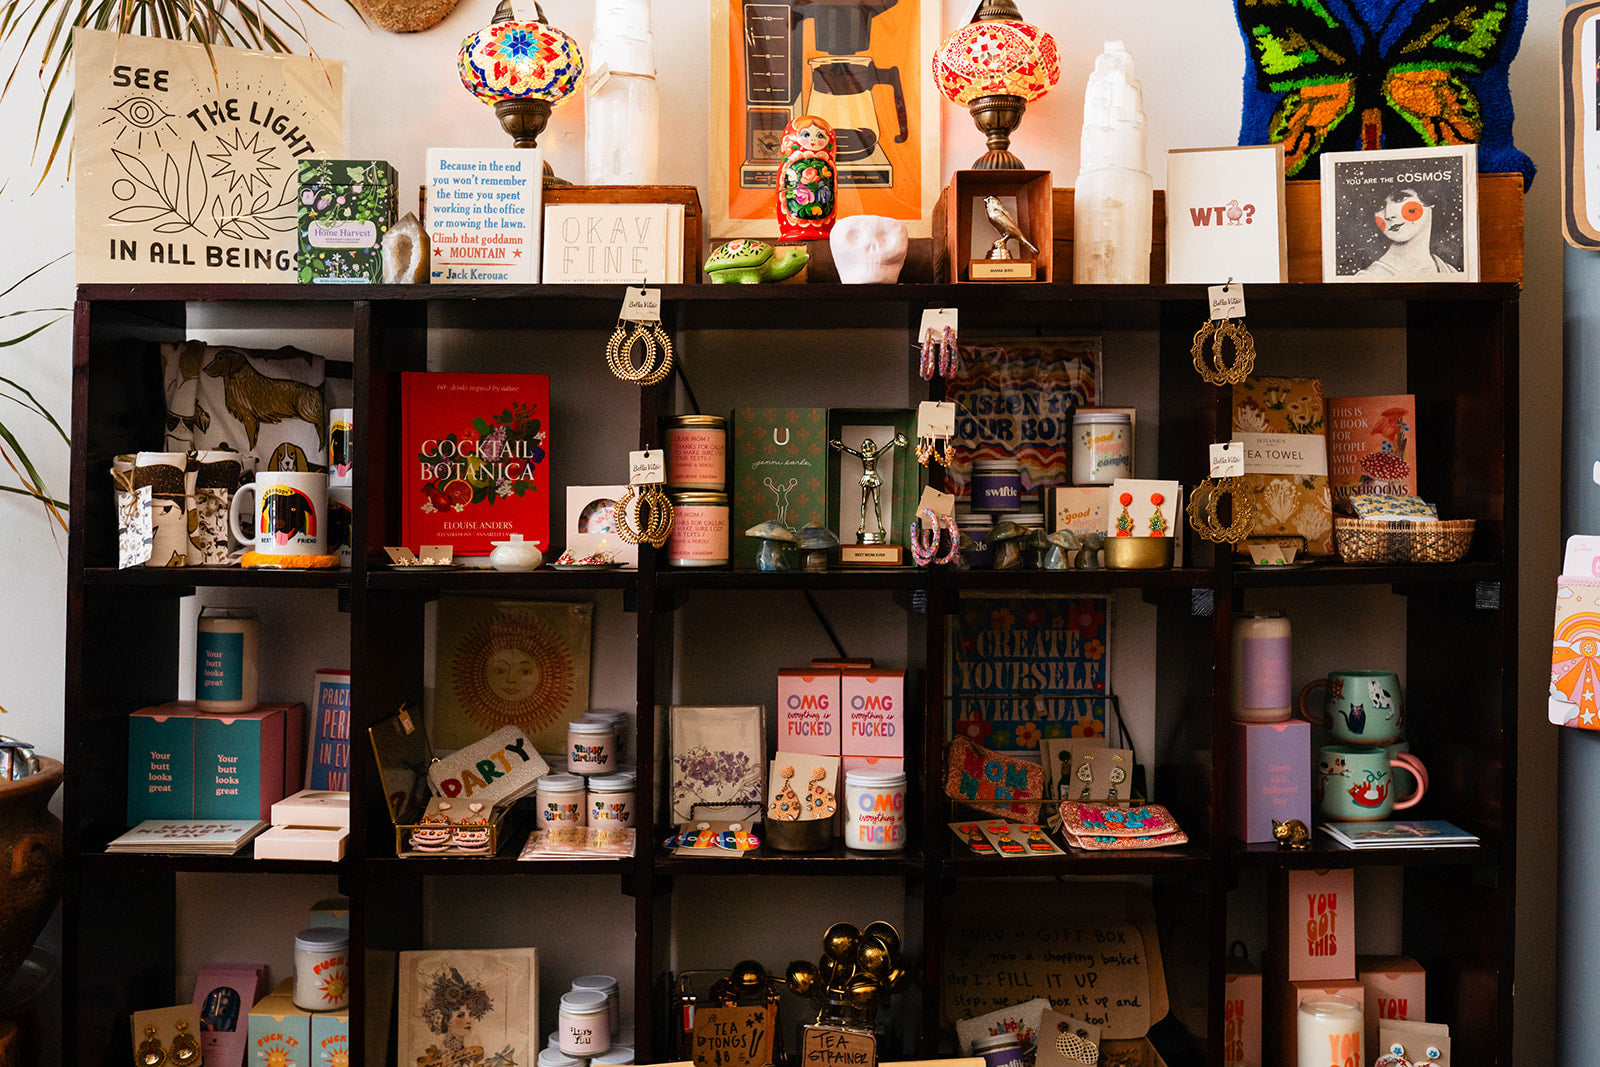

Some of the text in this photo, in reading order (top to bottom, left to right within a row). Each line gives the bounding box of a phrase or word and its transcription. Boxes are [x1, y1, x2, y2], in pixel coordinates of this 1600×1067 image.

[113, 65, 169, 92] SEE
[186, 98, 316, 157] THE LIGHT
[440, 159, 522, 172] Because in the end
[432, 177, 450, 187] you
[481, 175, 527, 186] remember
[1346, 178, 1361, 186] YOU
[1363, 177, 1378, 185] ARE
[1396, 170, 1452, 184] COSMOS
[436, 188, 521, 202] the time you spent
[433, 203, 525, 216] working in the office
[433, 218, 526, 230] or mowing the lawn.
[562, 216, 652, 244] OKAY
[314, 229, 372, 238] Home Harvest
[432, 232, 523, 246] Climb that goddamn
[109, 239, 138, 262] IN
[149, 242, 196, 266] ALL
[450, 247, 506, 259] MOUNTAIN
[563, 246, 648, 273] FINE
[446, 268, 508, 280] Jack Kerouac
[1332, 407, 1363, 418] THIS IS
[1339, 418, 1368, 429] BOOK
[1088, 430, 1114, 450] good
[1332, 432, 1351, 441] FOR
[421, 439, 534, 458] COCKTAIL
[1332, 442, 1367, 452] PEOPLE
[1244, 449, 1304, 460] EA TOWEL
[1332, 456, 1357, 465] WHO
[420, 462, 535, 480] BOTANICA
[1333, 465, 1356, 476] LOVE
[985, 485, 1018, 497] swiftie
[1333, 484, 1409, 497] MUSHROOMS
[1065, 507, 1091, 525] good
[443, 521, 513, 530] ELOUISE ANDERS
[976, 629, 1081, 658] CREATE
[206, 650, 223, 659] Your
[205, 659, 222, 668] butt
[204, 669, 224, 677] looks
[957, 661, 1100, 690] YOURSELF
[204, 679, 224, 688] great
[787, 694, 829, 710] OMG
[850, 694, 893, 711] OMG
[786, 711, 831, 721] everything is
[850, 712, 895, 722] everything is
[788, 721, 832, 736] FUCKED
[852, 722, 896, 737] FUCKED
[150, 751, 171, 761] Your
[573, 743, 604, 756] Happy
[217, 754, 239, 763] Your
[571, 752, 608, 766] Birthday
[150, 761, 170, 771] butt
[217, 764, 237, 774] butt
[148, 772, 172, 782] looks
[215, 775, 239, 785] looks
[148, 783, 172, 793] great
[215, 787, 239, 797] great
[547, 802, 578, 815] Happy
[595, 801, 626, 814] Happy
[858, 792, 904, 812] OMG
[543, 810, 582, 824] Birthday
[592, 809, 630, 824] Birthday
[858, 812, 896, 825] everything
[161, 823, 233, 831] HAPPY
[716, 836, 758, 845] LOVE
[1307, 892, 1337, 918] YOU
[1306, 909, 1337, 941] GOT
[1037, 926, 1082, 943] GIFT
[1095, 927, 1126, 945] BOX
[1306, 933, 1337, 957] THIS
[987, 950, 1020, 964] grab
[1043, 949, 1095, 968] shopping
[1101, 950, 1141, 966] basket
[313, 956, 344, 976] FUCK
[997, 971, 1033, 988] FILL
[1046, 972, 1062, 988] IT
[1074, 972, 1098, 988] UP
[992, 996, 1009, 1006] we
[1048, 995, 1071, 1007] box
[1077, 995, 1089, 1007] it
[1095, 995, 1108, 1009] up
[1116, 995, 1142, 1008] and
[1377, 998, 1408, 1020] YOU
[1084, 1012, 1111, 1028] too!
[714, 1022, 739, 1036] TEA
[257, 1033, 299, 1048] FUCK IT
[320, 1034, 347, 1049] FUCK
[708, 1033, 748, 1050] TONGS
[812, 1031, 849, 1050] TEA
[808, 1049, 869, 1066] STRAINER
